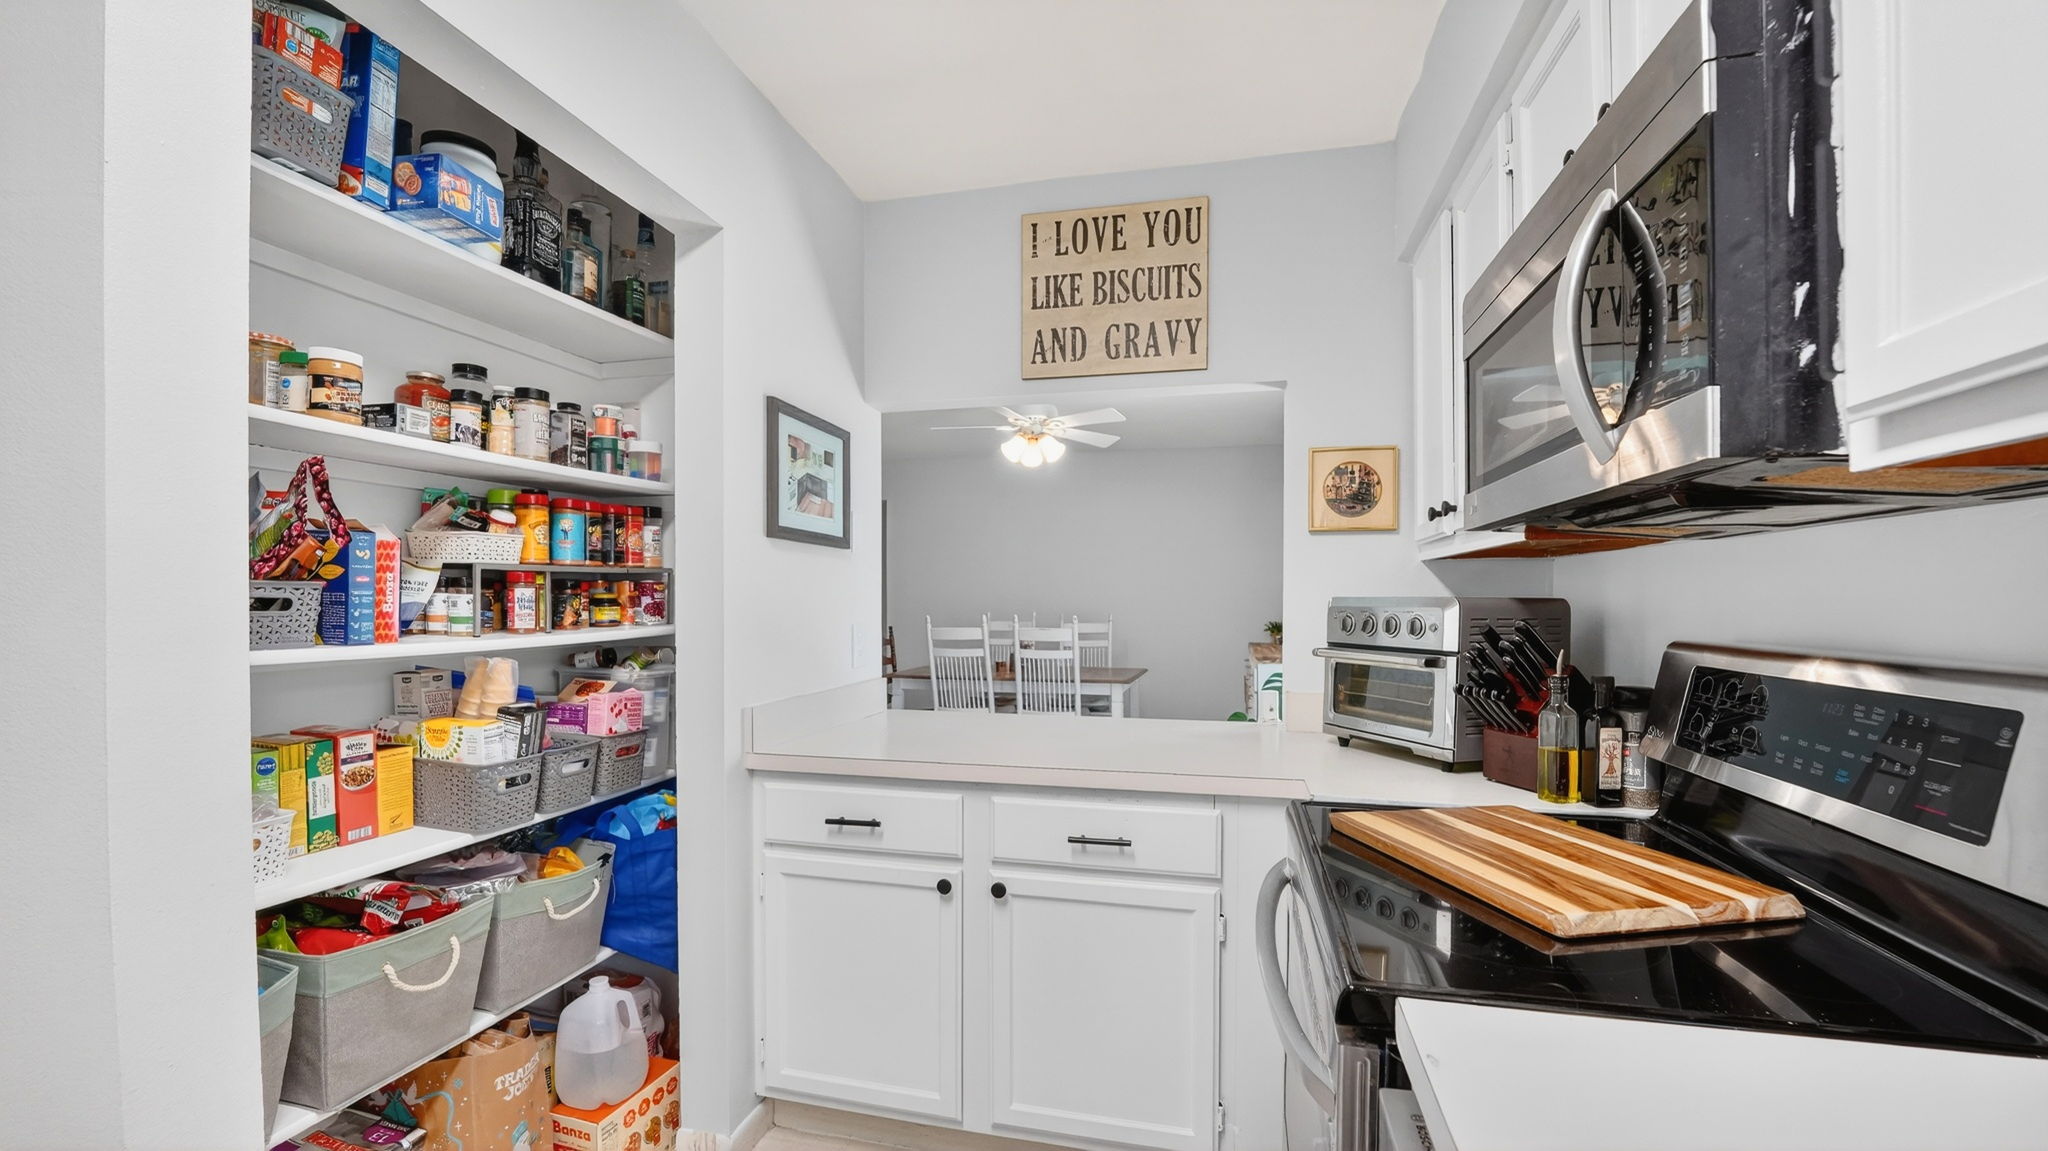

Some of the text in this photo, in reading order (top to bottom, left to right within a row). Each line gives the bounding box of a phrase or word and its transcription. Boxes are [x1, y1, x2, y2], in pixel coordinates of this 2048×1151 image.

[1031, 206, 1202, 258] I LOVE YOU
[1031, 263, 1202, 310] LIKE BISCUITS
[1031, 318, 1202, 364] AND GRAVY
[382, 572, 395, 613] Banza
[1907, 715, 1914, 725] 2
[1922, 718, 1930, 727] 3
[1886, 736, 1893, 744] 4
[1901, 739, 1908, 748] 5
[1916, 742, 1923, 752] 6
[1880, 758, 1916, 775] 7 8 9
[552, 1120, 591, 1142] Banza
